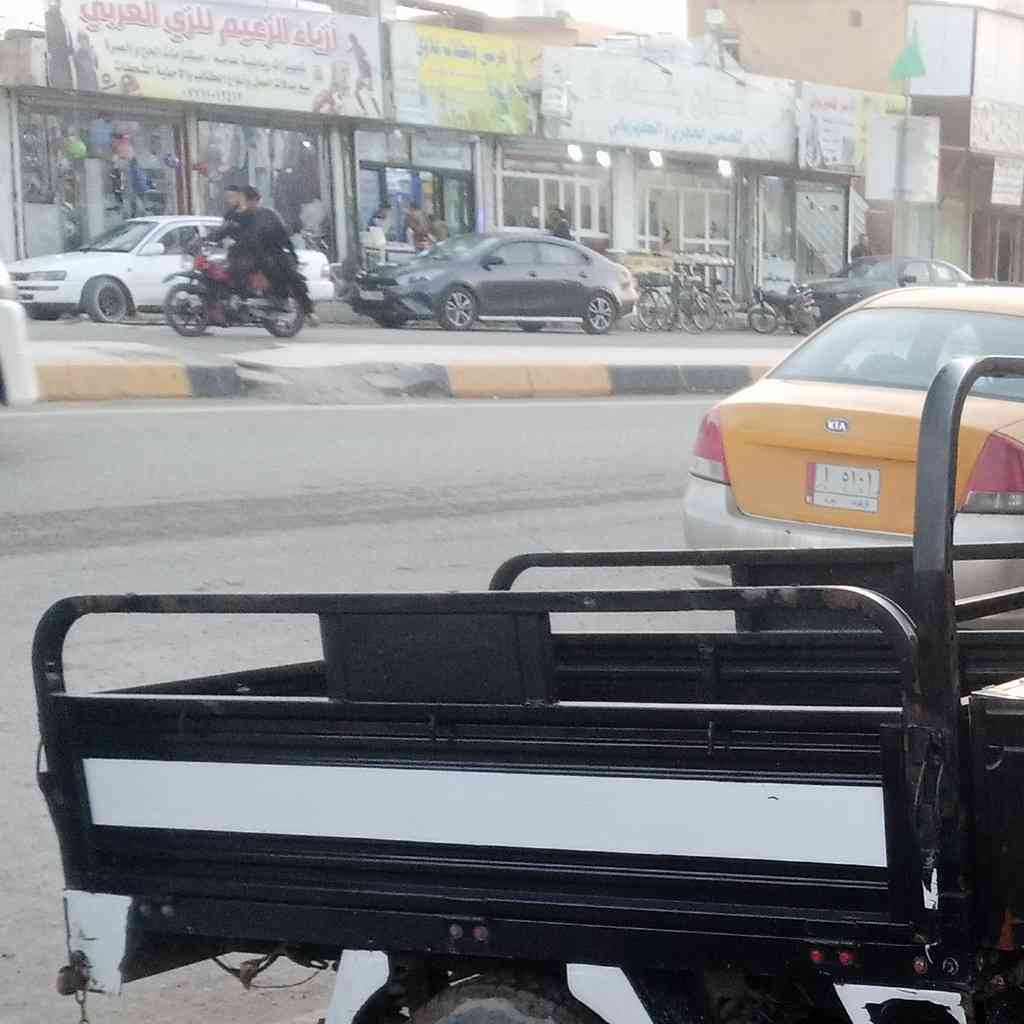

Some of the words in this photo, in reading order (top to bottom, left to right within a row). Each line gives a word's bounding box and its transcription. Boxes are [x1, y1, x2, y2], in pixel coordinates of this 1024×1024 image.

[79, 0, 160, 33] العربي
[162, 5, 214, 43] للزي
[219, 15, 288, 48] الزعيم
